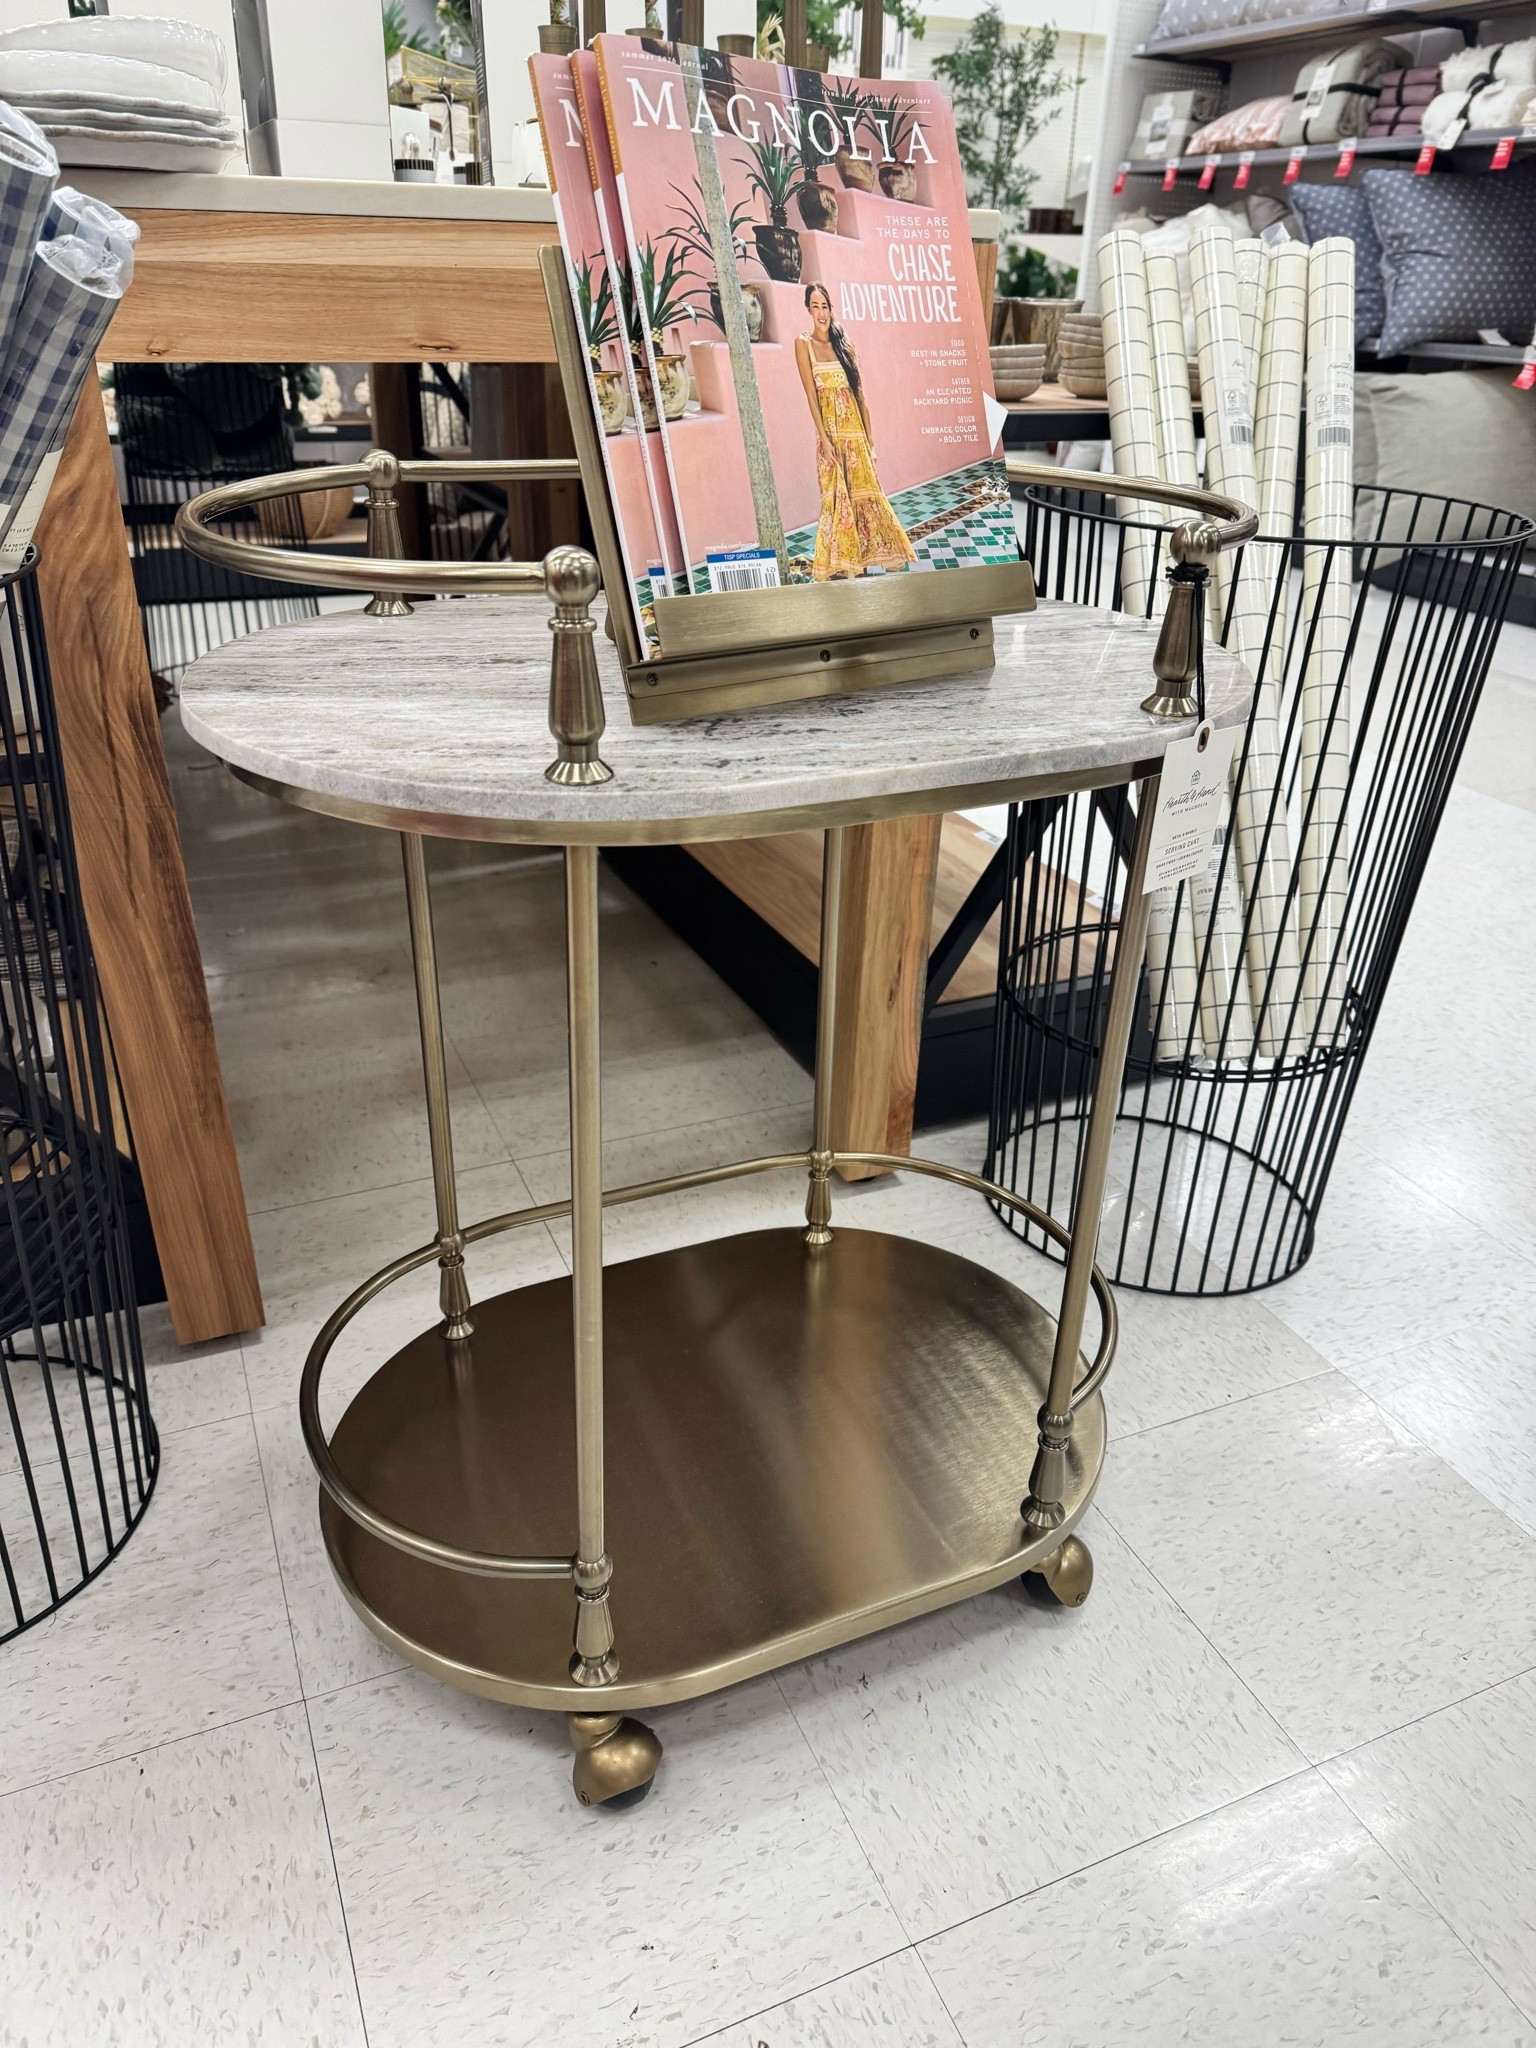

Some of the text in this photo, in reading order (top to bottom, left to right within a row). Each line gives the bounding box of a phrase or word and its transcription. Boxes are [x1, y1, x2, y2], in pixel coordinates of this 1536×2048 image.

[621, 50, 654, 61] summer
[893, 96, 932, 104] adventure
[626, 77, 938, 164] MAGNOLIA
[884, 216, 948, 227] THESE ARE
[876, 228, 950, 239] THE DAYS TO
[888, 243, 956, 282] CHASE
[840, 282, 962, 324] ADVENTURE
[952, 377, 970, 385] GATHER
[926, 388, 972, 396] AN ELEVATED
[914, 396, 973, 406] BACKYARD PICNIC
[964, 434, 979, 442] TILE
[1162, 788, 1194, 813] Hearth
[1194, 781, 1222, 802] Hand
[1185, 802, 1208, 812] MAGNOLIA
[1164, 838, 1200, 856] SERVING CART
